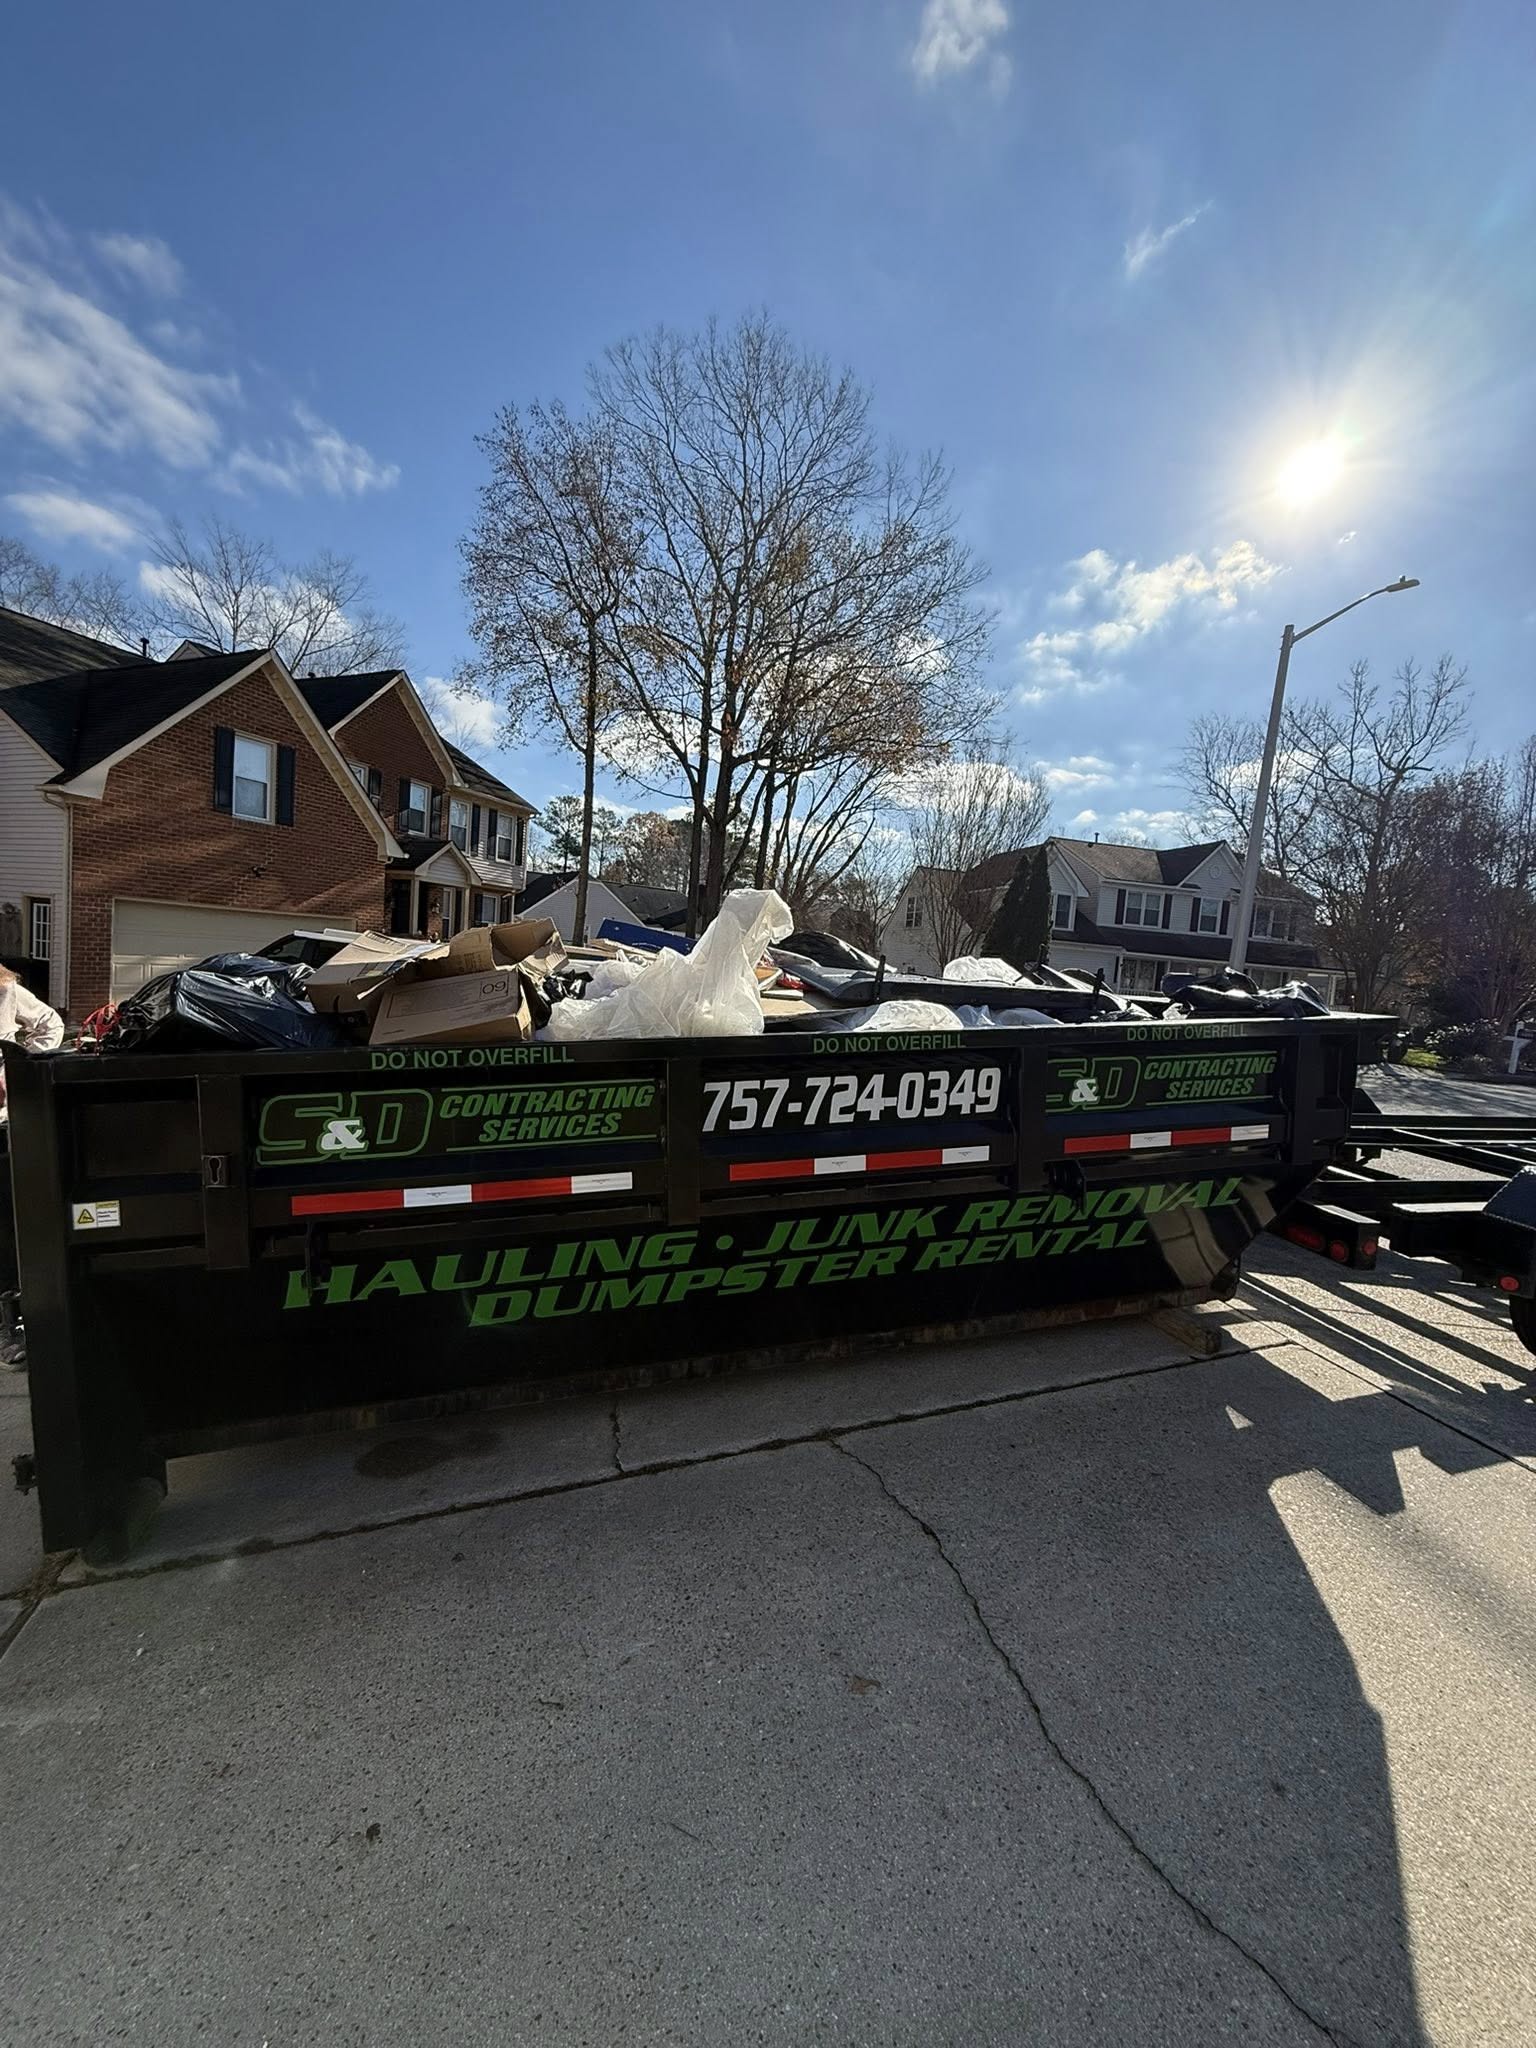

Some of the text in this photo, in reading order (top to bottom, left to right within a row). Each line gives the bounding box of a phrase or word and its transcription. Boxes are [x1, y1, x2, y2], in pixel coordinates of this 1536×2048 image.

[813, 1034, 966, 1053] DO NOT OVERFILL
[1127, 1024, 1248, 1041] DO NOT OVERFILL
[371, 1046, 575, 1070] DO NOT OVERFILL
[1144, 1056, 1277, 1080] CONTRACTING
[439, 1085, 657, 1119] CONTRACTING
[702, 1067, 1002, 1132] 757-724-0349
[1166, 1077, 1255, 1100] SERVICES
[478, 1112, 622, 1143] SERVICES
[283, 1177, 1243, 1309] HAULING JUNK REMOVAL
[468, 1219, 1148, 1327] DUMPSTER RENTAL
